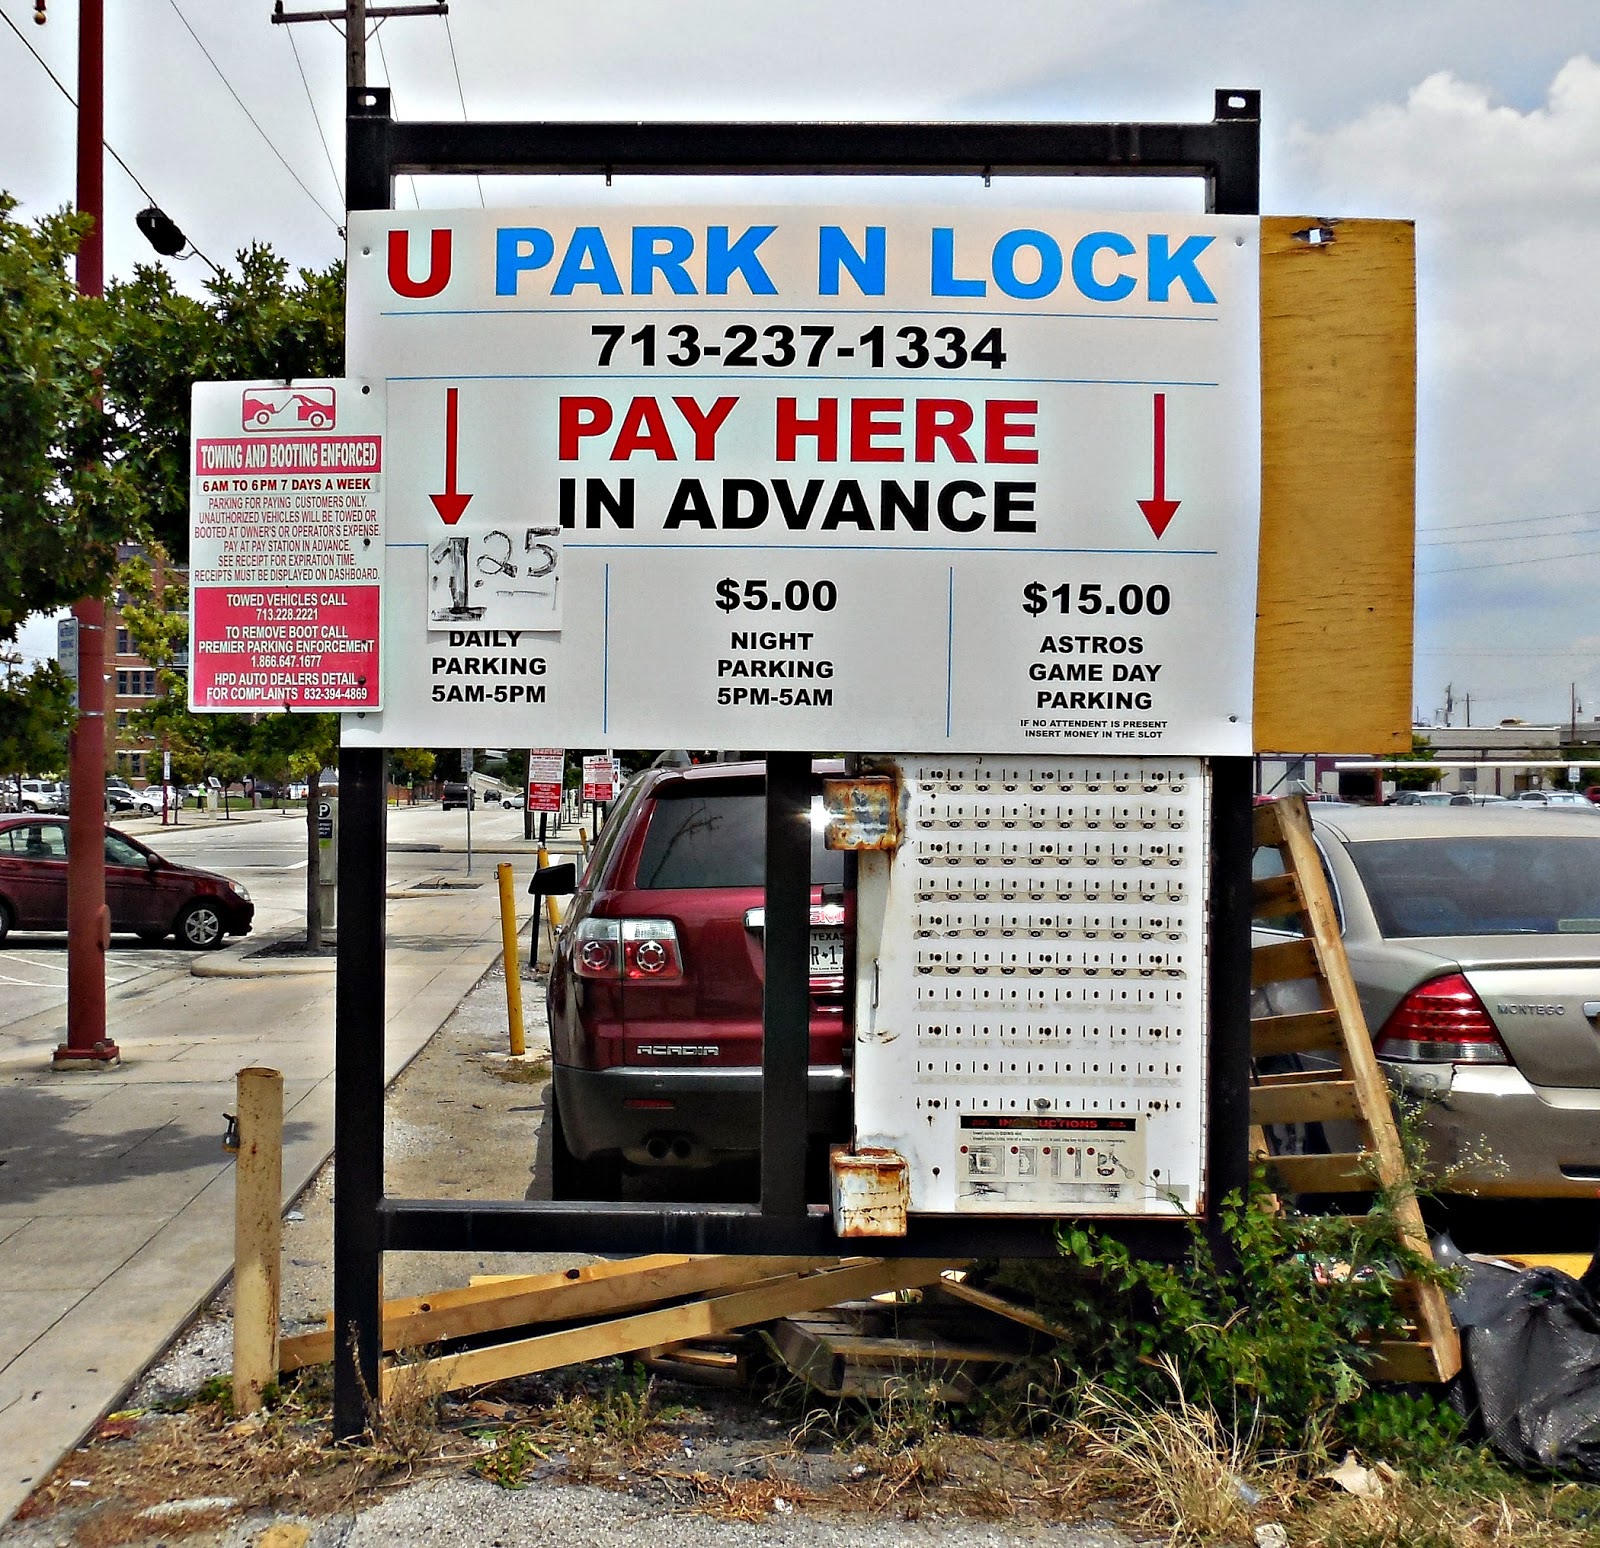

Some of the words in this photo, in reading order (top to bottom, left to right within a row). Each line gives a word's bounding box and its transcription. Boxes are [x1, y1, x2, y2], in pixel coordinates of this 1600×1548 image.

[388, 228, 452, 298] U
[495, 226, 780, 297] PARK
[818, 226, 886, 296] N
[931, 227, 1218, 303] LOCK
[591, 324, 1007, 369] 713-237-1334
[558, 396, 740, 462] PAY
[775, 397, 1039, 464] HERE
[201, 444, 242, 469] TOWING
[245, 444, 267, 468] AND
[270, 443, 318, 468] BOOTING
[321, 442, 377, 467] ENFORCED
[233, 480, 248, 491] TO
[281, 479, 288, 491] 7
[292, 479, 321, 491] DAYS
[325, 478, 333, 490] A
[337, 478, 371, 490] WEEK
[209, 497, 243, 510] PARKING
[245, 497, 261, 509] FOR
[263, 496, 291, 509] PAYING
[295, 495, 343, 508] CUSTOMERS
[346, 495, 367, 507] ONLY.
[558, 478, 632, 529] IN
[662, 478, 1037, 533] ADVANCE
[199, 511, 259, 524] UNAUTHORIZED
[261, 511, 299, 523] VEHICLES
[302, 510, 320, 522] WILL
[322, 510, 332, 522] BE
[334, 510, 363, 522] TOWED
[365, 510, 377, 522] OR
[195, 526, 227, 539] BOOTED
[229, 526, 239, 538] AT
[240, 525, 276, 538] OWNER'S
[278, 525, 290, 537] OR
[292, 525, 341, 537] OPERATOR'S
[343, 524, 381, 537] EXPENSE.
[224, 540, 238, 552] PAY
[240, 540, 250, 552] AT
[252, 540, 265, 552] PAY
[268, 539, 300, 552] STATION
[303, 539, 310, 551] IN
[312, 539, 351, 551] ADVANCE.
[218, 555, 233, 567] SEE
[236, 554, 269, 567] RECEIPT
[271, 554, 287, 566] FOR
[289, 554, 334, 566] EXPIRATION
[336, 553, 357, 566] TIME.
[195, 569, 232, 581] RECEIPTS
[235, 569, 256, 581] MUST
[258, 569, 268, 581] BE
[270, 568, 313, 581] DISPLAYED
[315, 568, 326, 580] ON
[329, 568, 380, 580] DASHBOARD.
[227, 593, 264, 607] TOWED
[266, 593, 318, 606] VEHICLES
[321, 593, 348, 606] CALL
[715, 577, 838, 614] $5.00
[1022, 581, 1171, 617] $15.00
[256, 608, 318, 621] 713.228.2221
[225, 626, 240, 639] TO
[242, 626, 286, 639] REMOVE
[289, 625, 318, 639] BOOT
[321, 625, 348, 638] CALL
[449, 630, 522, 648] DAILY
[199, 640, 245, 653] PREMIER
[247, 640, 294, 653] PARKING
[296, 640, 375, 653] ENFORCEMENT
[730, 631, 814, 651] NIGHT
[1040, 635, 1144, 655] ASTROS
[251, 655, 322, 668] 1.866.647.1677
[432, 656, 547, 675] PARKING
[717, 659, 835, 679] PARKING
[215, 673, 236, 686] HPD
[238, 672, 268, 685] AUTO
[270, 672, 320, 685] DEALERS
[322, 672, 358, 685] DETAIL
[1029, 663, 1103, 681] GAME
[1112, 664, 1162, 682] DAY
[206, 687, 228, 700] FOR
[230, 687, 298, 700] COMPLAINTS
[304, 687, 367, 700] 832-394-4869
[431, 684, 546, 703] 5AM-5PM
[717, 687, 834, 707] 5PM-5AM
[1036, 691, 1152, 710] PARKING
[1020, 719, 1030, 727] IF
[1032, 719, 1047, 727] NO
[1111, 720, 1120, 728] IS
[1064, 730, 1099, 738] MONEY
[1497, 1003, 1565, 1016] MONTEGO
[637, 1045, 720, 1056] ACADIA
